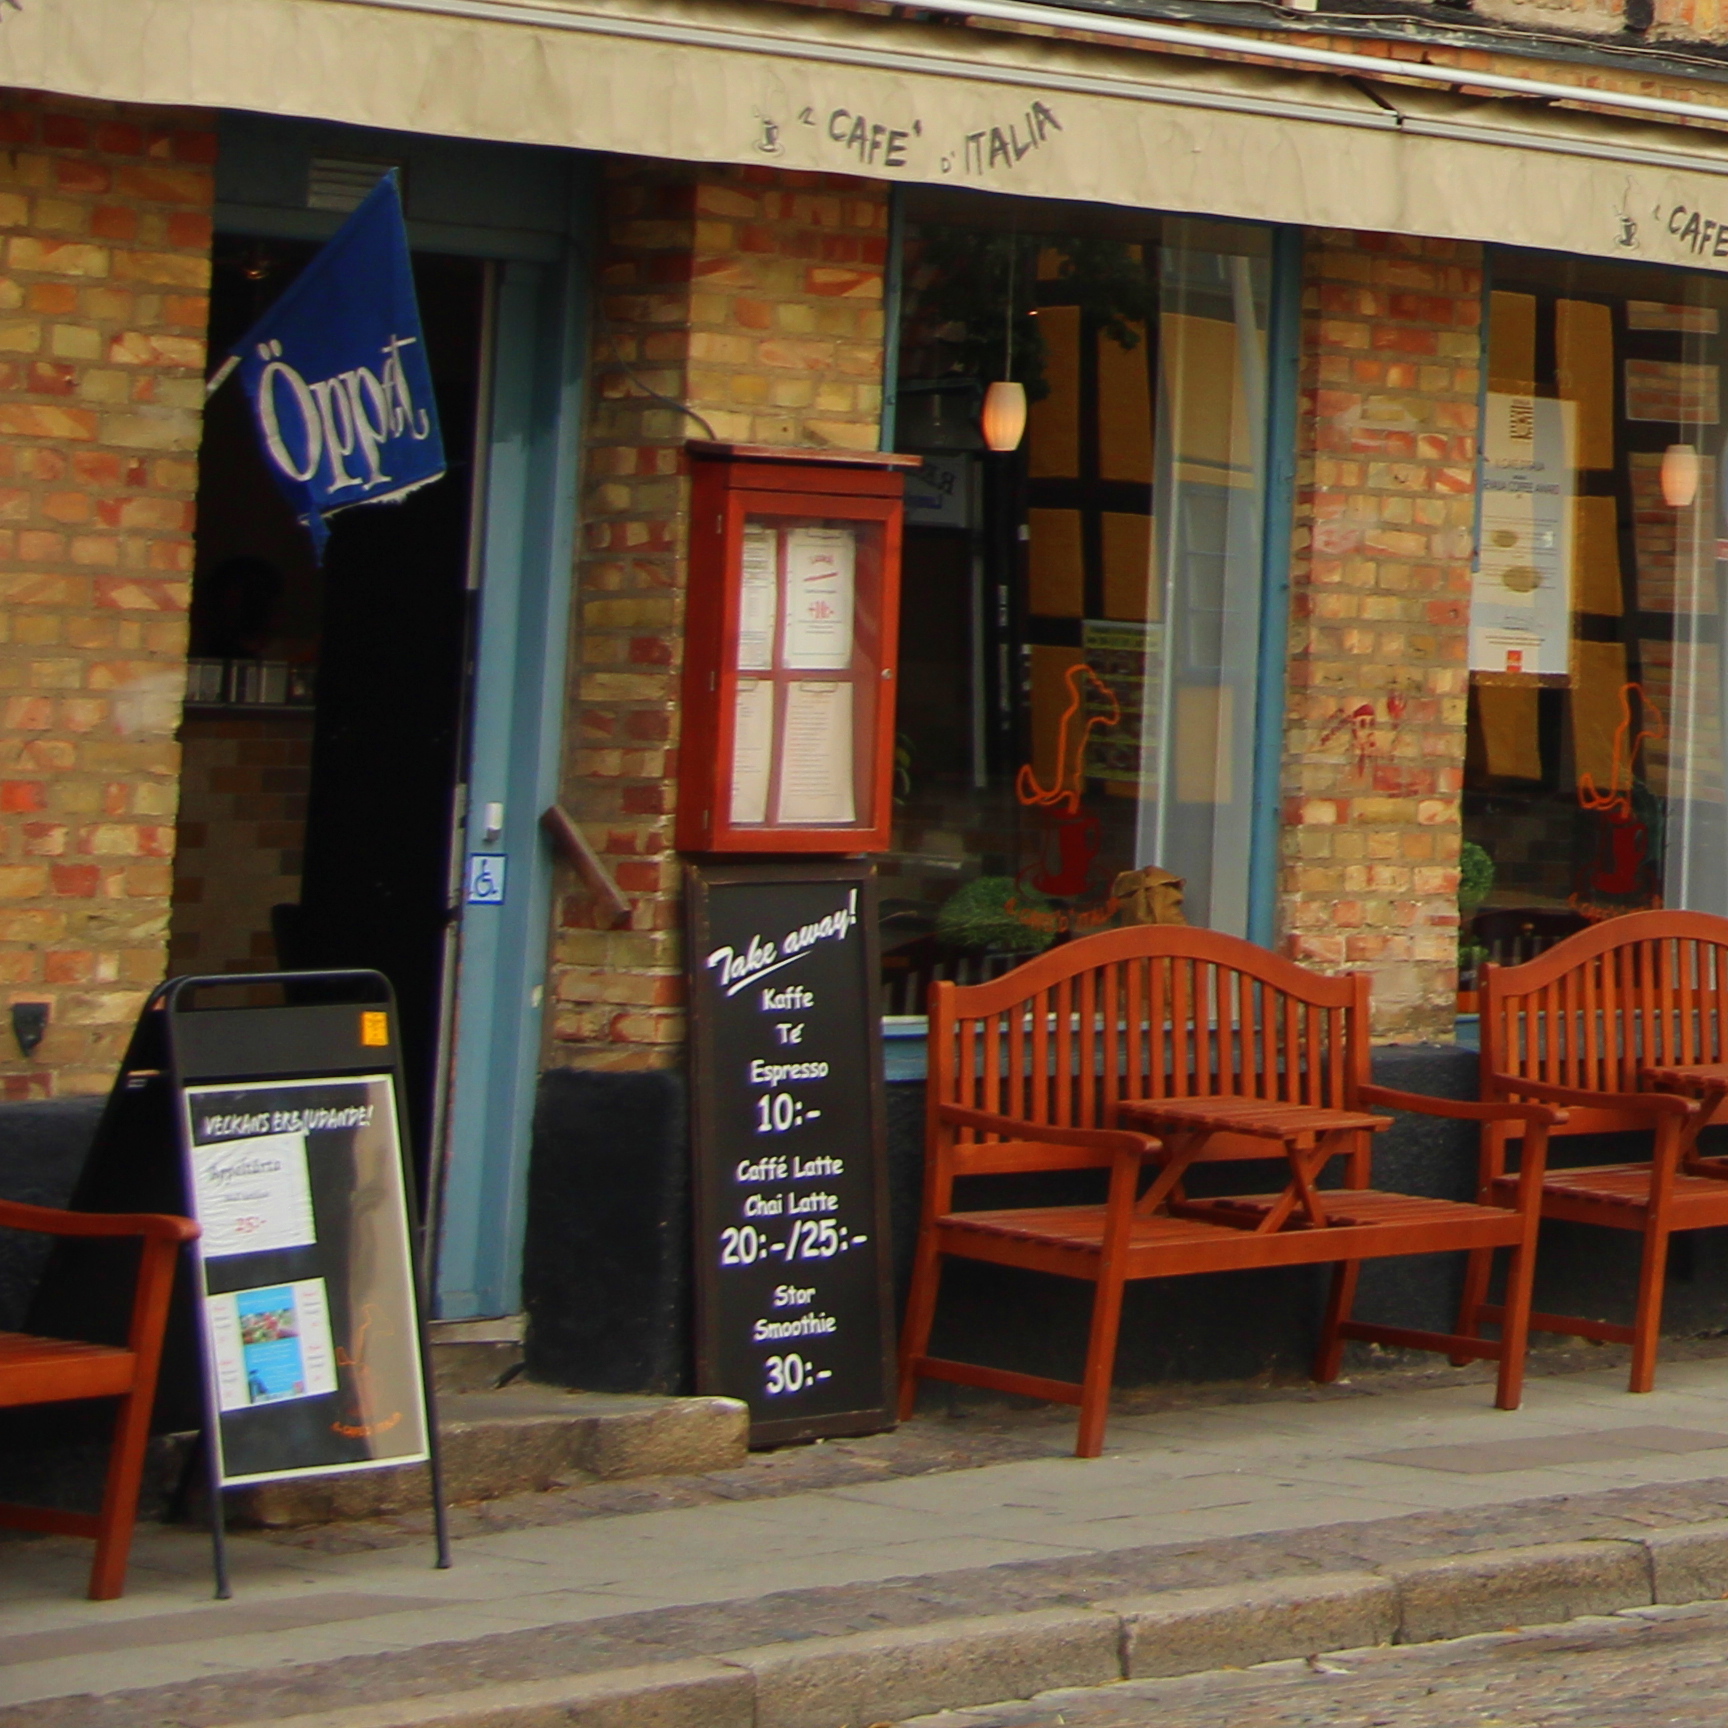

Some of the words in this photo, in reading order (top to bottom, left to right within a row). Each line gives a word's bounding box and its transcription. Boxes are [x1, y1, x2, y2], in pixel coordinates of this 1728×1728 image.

[257, 334, 430, 494] Öppet
[706, 934, 778, 987] Take
[782, 888, 858, 956] away!
[761, 985, 815, 1011] Kaffe
[774, 1021, 806, 1045] Té
[750, 1058, 830, 1088] Espresso
[756, 1092, 822, 1132] 10:-
[735, 1154, 789, 1183] Caffé
[792, 1155, 845, 1179] Latte
[743, 1193, 783, 1218] Chai
[786, 1191, 839, 1216] Latte
[719, 1218, 869, 1266] 20:-/25:-
[772, 1284, 816, 1308] Stor
[753, 1311, 837, 1342] Smoothie
[764, 1352, 833, 1395] 30:-
